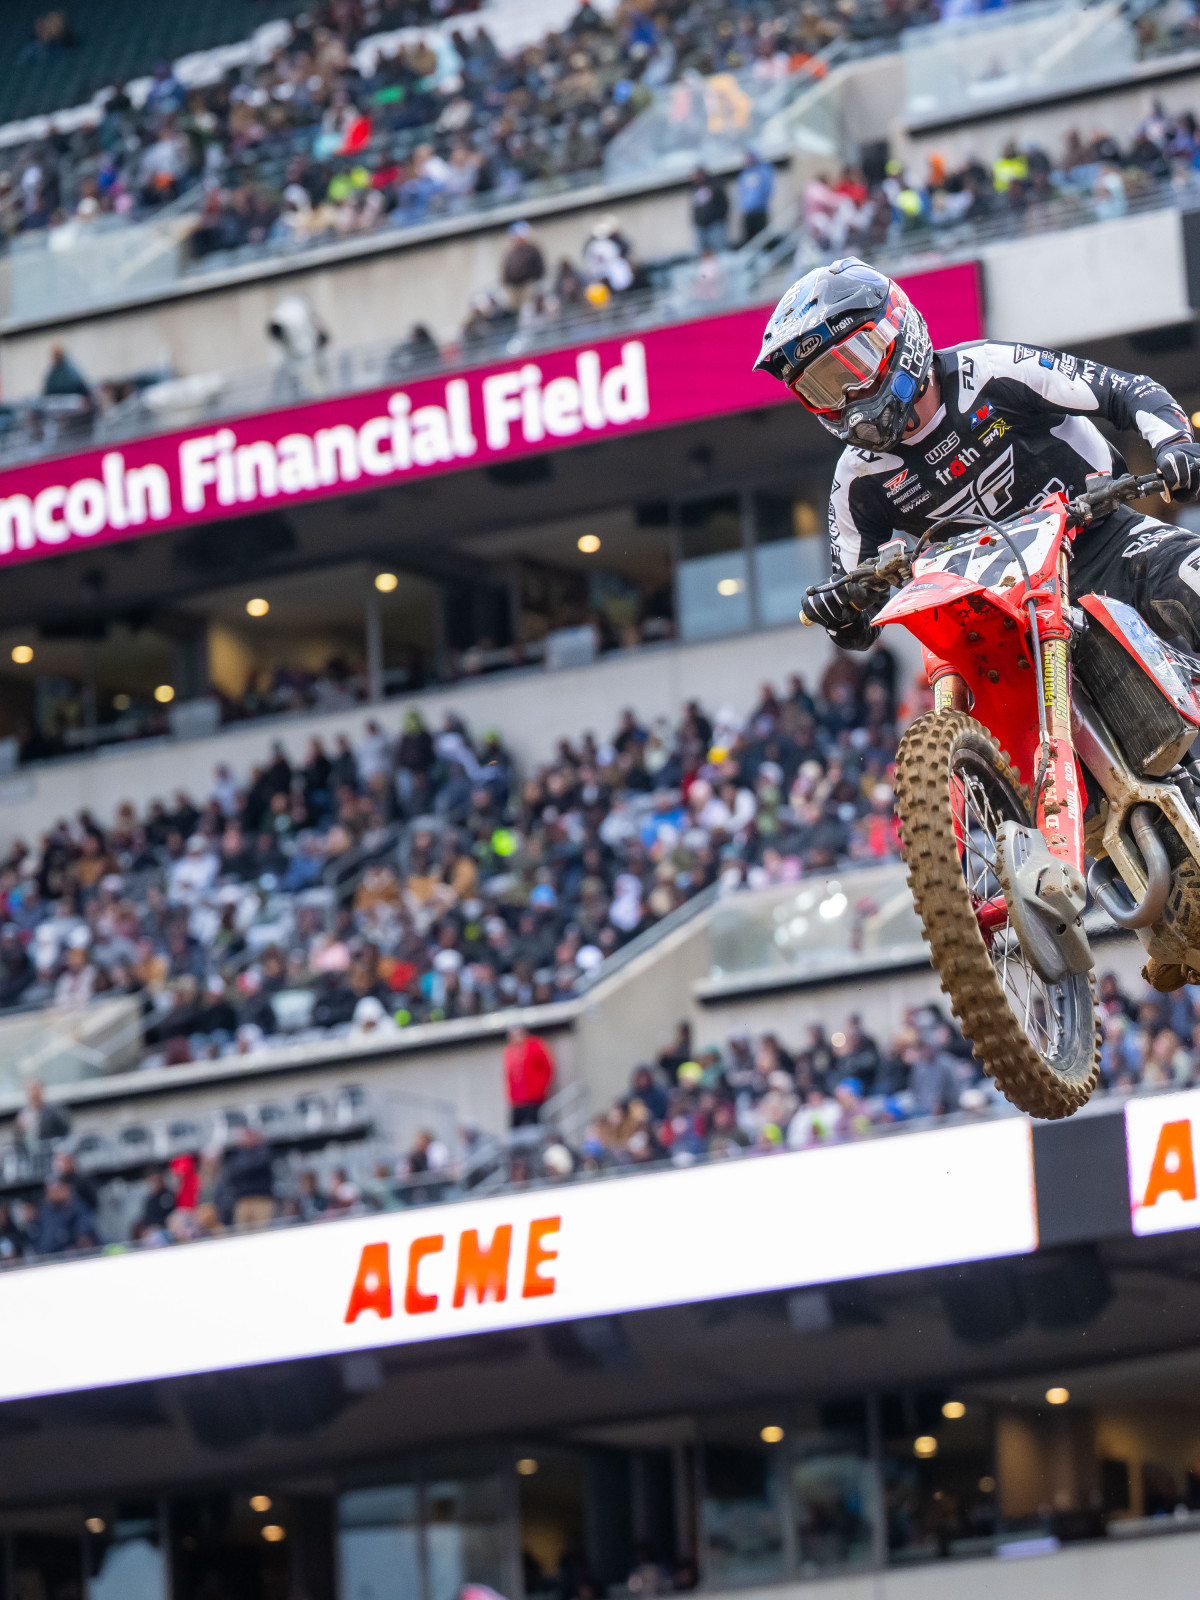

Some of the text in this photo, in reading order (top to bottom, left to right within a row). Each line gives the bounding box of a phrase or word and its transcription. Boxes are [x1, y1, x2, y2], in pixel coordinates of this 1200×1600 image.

[799, 336, 819, 355] Arai
[900, 323, 917, 370] QUAD
[962, 356, 974, 391] FLY
[179, 378, 477, 512] Financial
[482, 341, 650, 450] Field
[925, 431, 960, 465] WPS
[935, 445, 981, 486] froth
[1043, 650, 1055, 706] Factory
[1054, 640, 1068, 723] Connection
[345, 1217, 561, 1323] ACME
